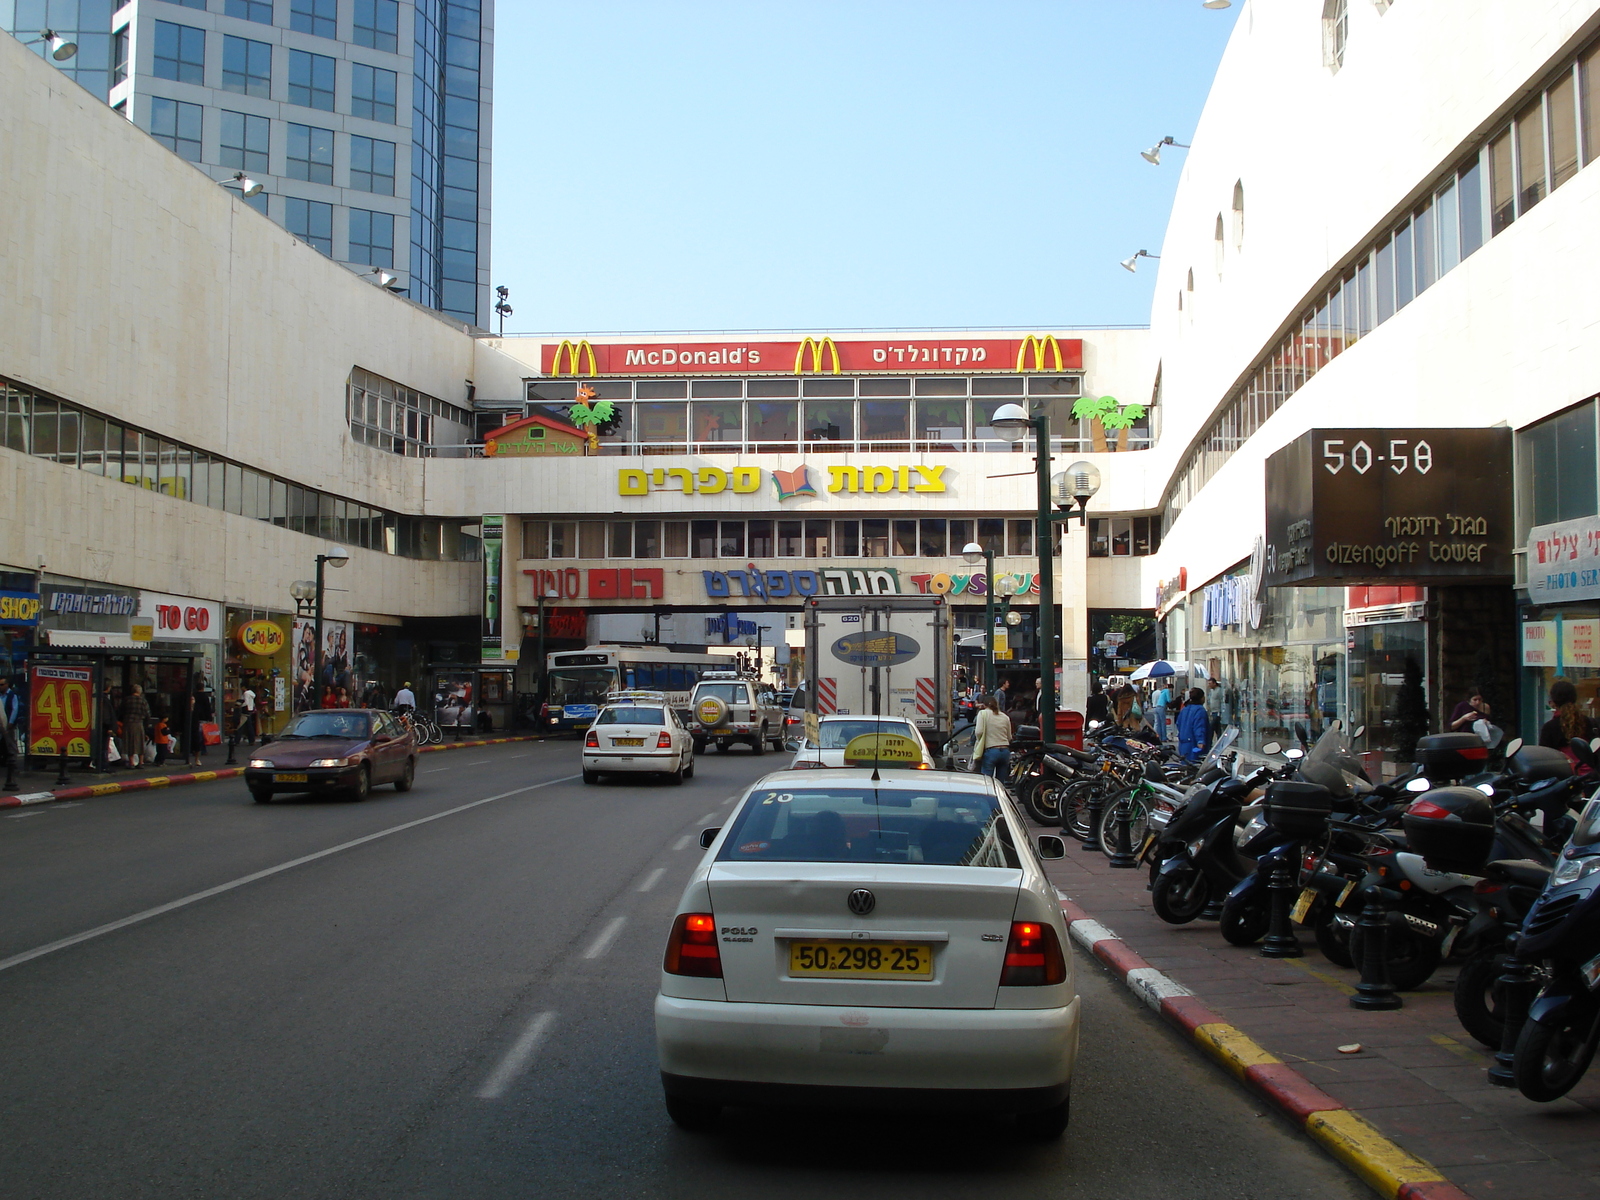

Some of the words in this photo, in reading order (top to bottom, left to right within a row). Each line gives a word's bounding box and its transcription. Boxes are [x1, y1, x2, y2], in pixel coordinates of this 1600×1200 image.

[625, 347, 761, 366] McDonald's
[872, 345, 987, 366] מקדונלד'ס
[497, 436, 545, 454] הילדים
[618, 466, 761, 496] ספרים
[827, 465, 947, 493] צומת
[1384, 515, 1441, 538] דיזנגוף
[1447, 513, 1487, 536] מגדל
[1326, 540, 1419, 569] dizengoff
[1429, 540, 1488, 563] tower
[1537, 530, 1579, 565] צילום
[588, 567, 664, 600] הום
[824, 569, 897, 596] מגה
[910, 573, 987, 596] TOYS
[1546, 571, 1577, 591] PHOTO
[0, 596, 39, 621] SHOP
[156, 604, 182, 631] TO
[184, 606, 210, 632] GO
[1525, 626, 1546, 640] PHOTO
[36, 681, 90, 732] 40
[70, 743, 85, 753] 15
[721, 926, 759, 936] POLO
